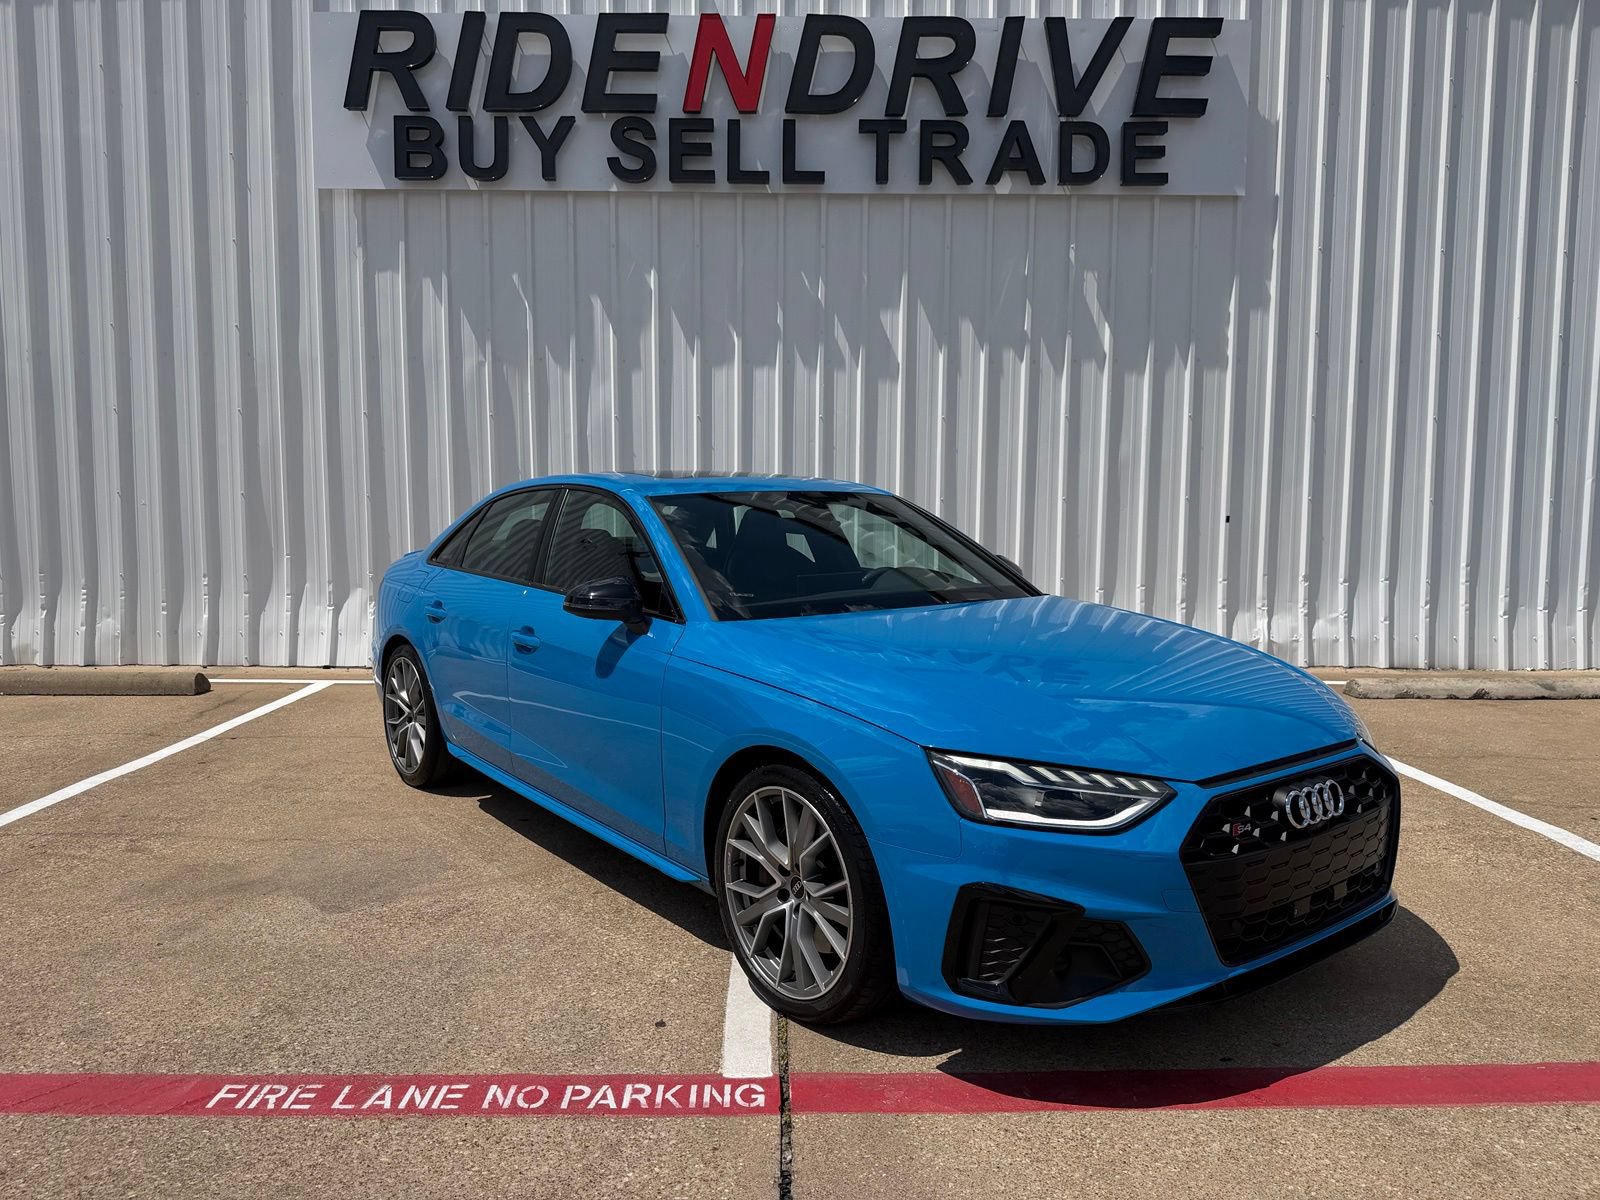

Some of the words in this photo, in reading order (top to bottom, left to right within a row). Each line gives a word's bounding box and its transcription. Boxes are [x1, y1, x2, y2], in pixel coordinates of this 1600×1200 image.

[393, 115, 576, 182] BUY
[606, 116, 825, 185] SELL
[858, 119, 1169, 186] TRADE
[205, 1084, 325, 1110] FIRE
[331, 1084, 470, 1110] LANE
[481, 1084, 549, 1110] NO
[560, 1083, 766, 1110] PARKING
